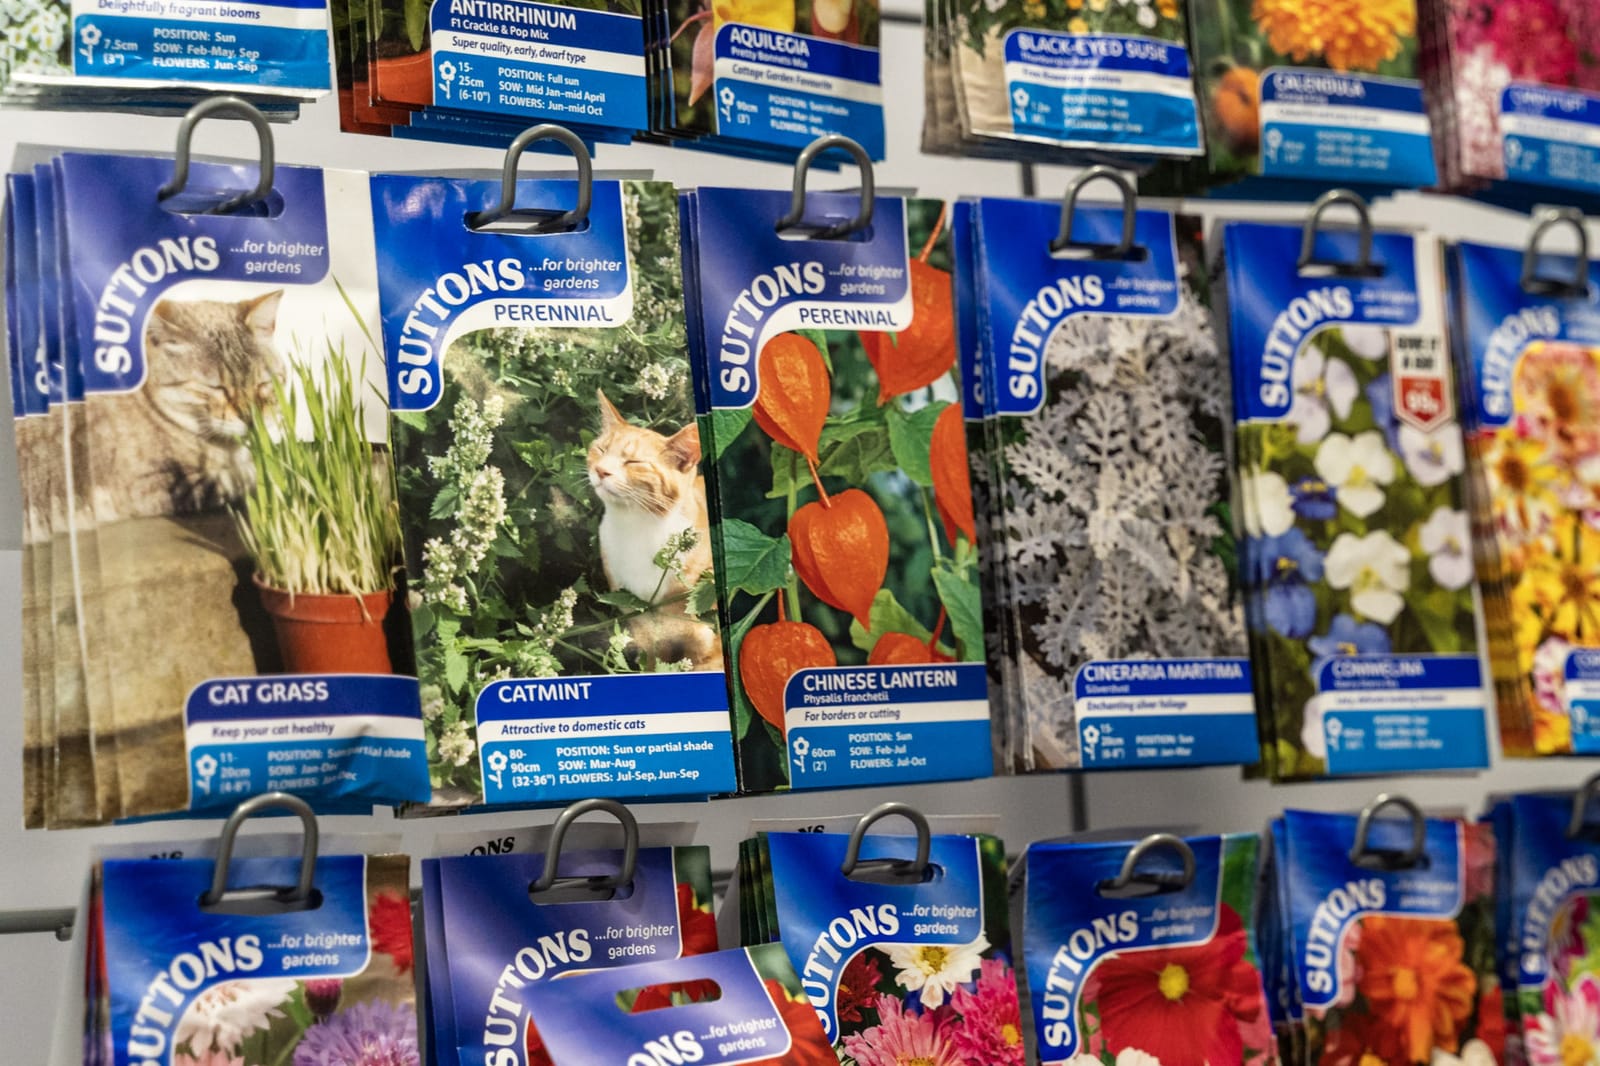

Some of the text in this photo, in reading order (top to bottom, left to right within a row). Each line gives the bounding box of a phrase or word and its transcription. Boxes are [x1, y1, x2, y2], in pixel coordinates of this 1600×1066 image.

[98, 0, 261, 20] Delightfully fragrant blooms
[450, 0, 577, 31] ANTIRRHINUM
[153, 27, 236, 43] POSITION: Sun
[463, 19, 499, 34] Crackle
[500, 26, 509, 35] &
[511, 26, 529, 40] Pop
[530, 29, 549, 40] Mix
[103, 38, 139, 51] 7.5cm
[452, 36, 587, 64] Super quality, early, dwarf type
[730, 27, 810, 57] AQUILEGIA
[153, 42, 183, 54] SOW:
[239, 48, 260, 62] Sep
[152, 56, 258, 73] FLOWERS: Jun-Sep
[458, 61, 474, 73] 15-
[458, 76, 485, 88] 25cm
[498, 67, 580, 86] POSITION: Full sun
[498, 81, 523, 93] SOW:
[526, 83, 544, 96] Mid
[584, 90, 606, 104] April
[499, 94, 545, 109] FLOWERS:
[586, 105, 603, 116] Oct
[267, 241, 324, 260] brighter
[245, 259, 302, 275] gardens
[566, 258, 622, 274] brighter
[858, 264, 904, 280] brighter
[544, 277, 599, 292] gardens
[840, 282, 885, 296] gardens
[93, 236, 220, 375] SUTTONS
[494, 304, 613, 322] PERENNIAL
[799, 307, 898, 326] PERENNIAL
[397, 258, 525, 396] SUTTONS
[720, 261, 826, 393] SUTTONS
[1008, 274, 1105, 400] SUTTONS
[1259, 286, 1354, 408] SUTTONS
[803, 669, 958, 692] CHINESE LANTERN
[1083, 663, 1243, 682] CINERARIA MARITIMA
[208, 681, 329, 705] CAT GRASS
[498, 682, 592, 703] CATMINT
[803, 692, 842, 706] Physalis
[805, 708, 900, 721] For borders or cutting
[212, 722, 335, 740] Keep your cat healthy
[501, 719, 646, 736] Attractive to domestic cats
[848, 731, 912, 743] POSITION: Sun
[383, 747, 411, 759] shade
[509, 749, 527, 760] 80-
[556, 740, 714, 758] POSITION: Sun or partial shade
[811, 747, 836, 758] 60cm
[849, 745, 907, 756] SOW: Feb-Jul
[510, 762, 540, 774] 90cm
[558, 758, 636, 771] SOW: Mar-Aug
[850, 756, 927, 769] FLOWERS: Jul-Oct
[560, 772, 613, 785] FLOWERS:
[658, 769, 700, 781] Jun-Sep
[931, 904, 978, 919] brighter
[626, 923, 675, 939] brighter
[914, 923, 959, 936] gardens
[1305, 878, 1386, 994] SUTTONS
[304, 932, 361, 949] brighter
[608, 943, 656, 958] gardens
[282, 953, 339, 970] gardens
[1042, 910, 1138, 1048] SUTTONS
[127, 934, 263, 1066] UTTONS
[484, 928, 592, 1066] SUTTONS
[728, 1017, 777, 1036] brighter
[717, 1037, 767, 1057] gardens
